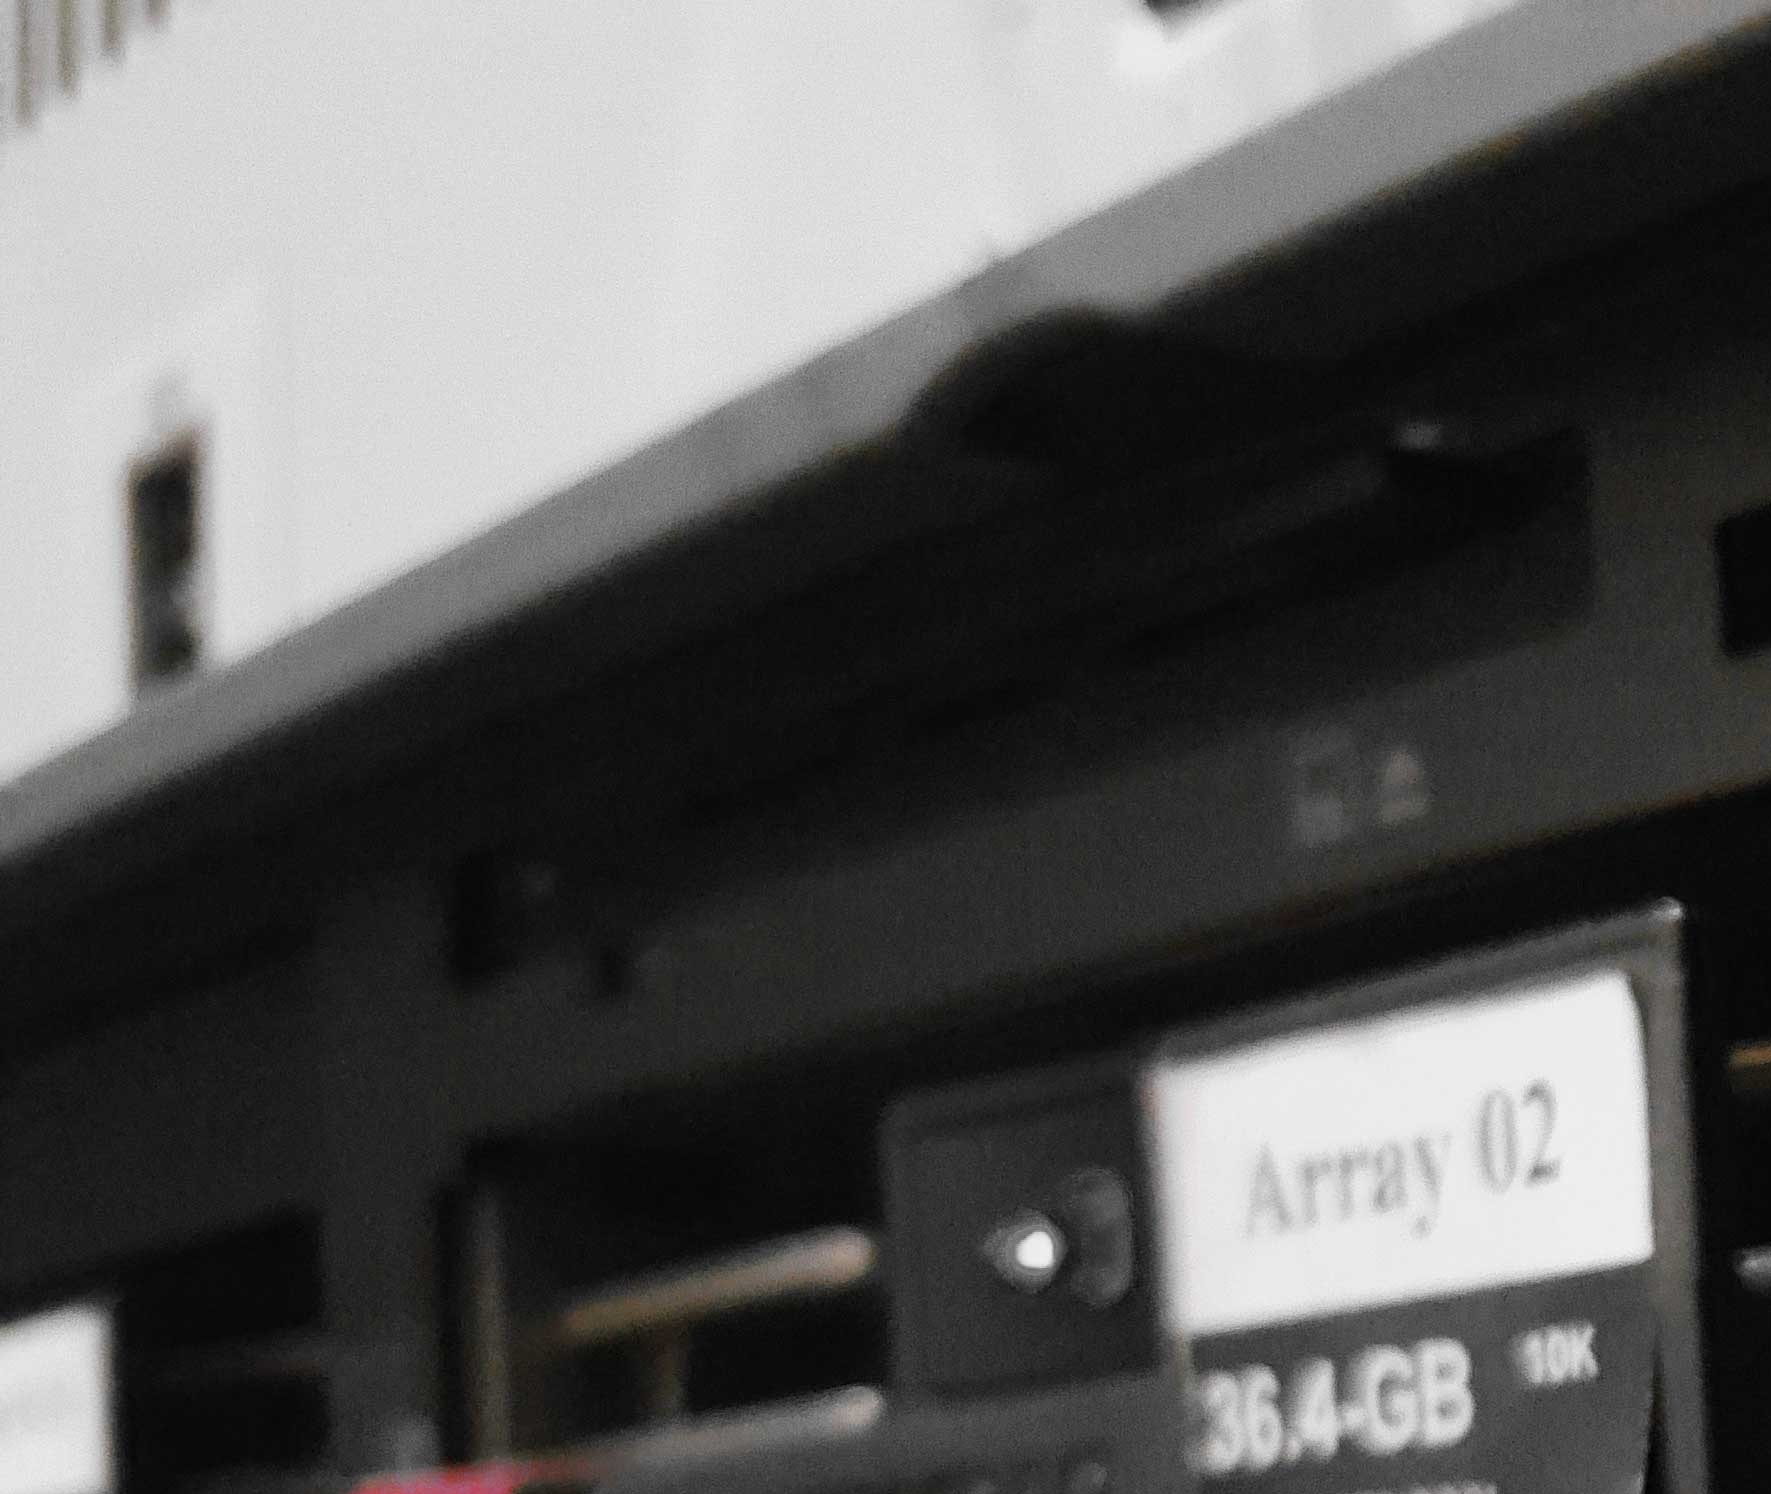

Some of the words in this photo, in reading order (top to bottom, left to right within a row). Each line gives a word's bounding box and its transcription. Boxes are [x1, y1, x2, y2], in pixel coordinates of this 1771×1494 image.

[1242, 1118, 1452, 1238] Array
[1474, 1076, 1562, 1195] 02
[1195, 1338, 1475, 1472] 36.4-GB
[1518, 1320, 1600, 1387] 10K
